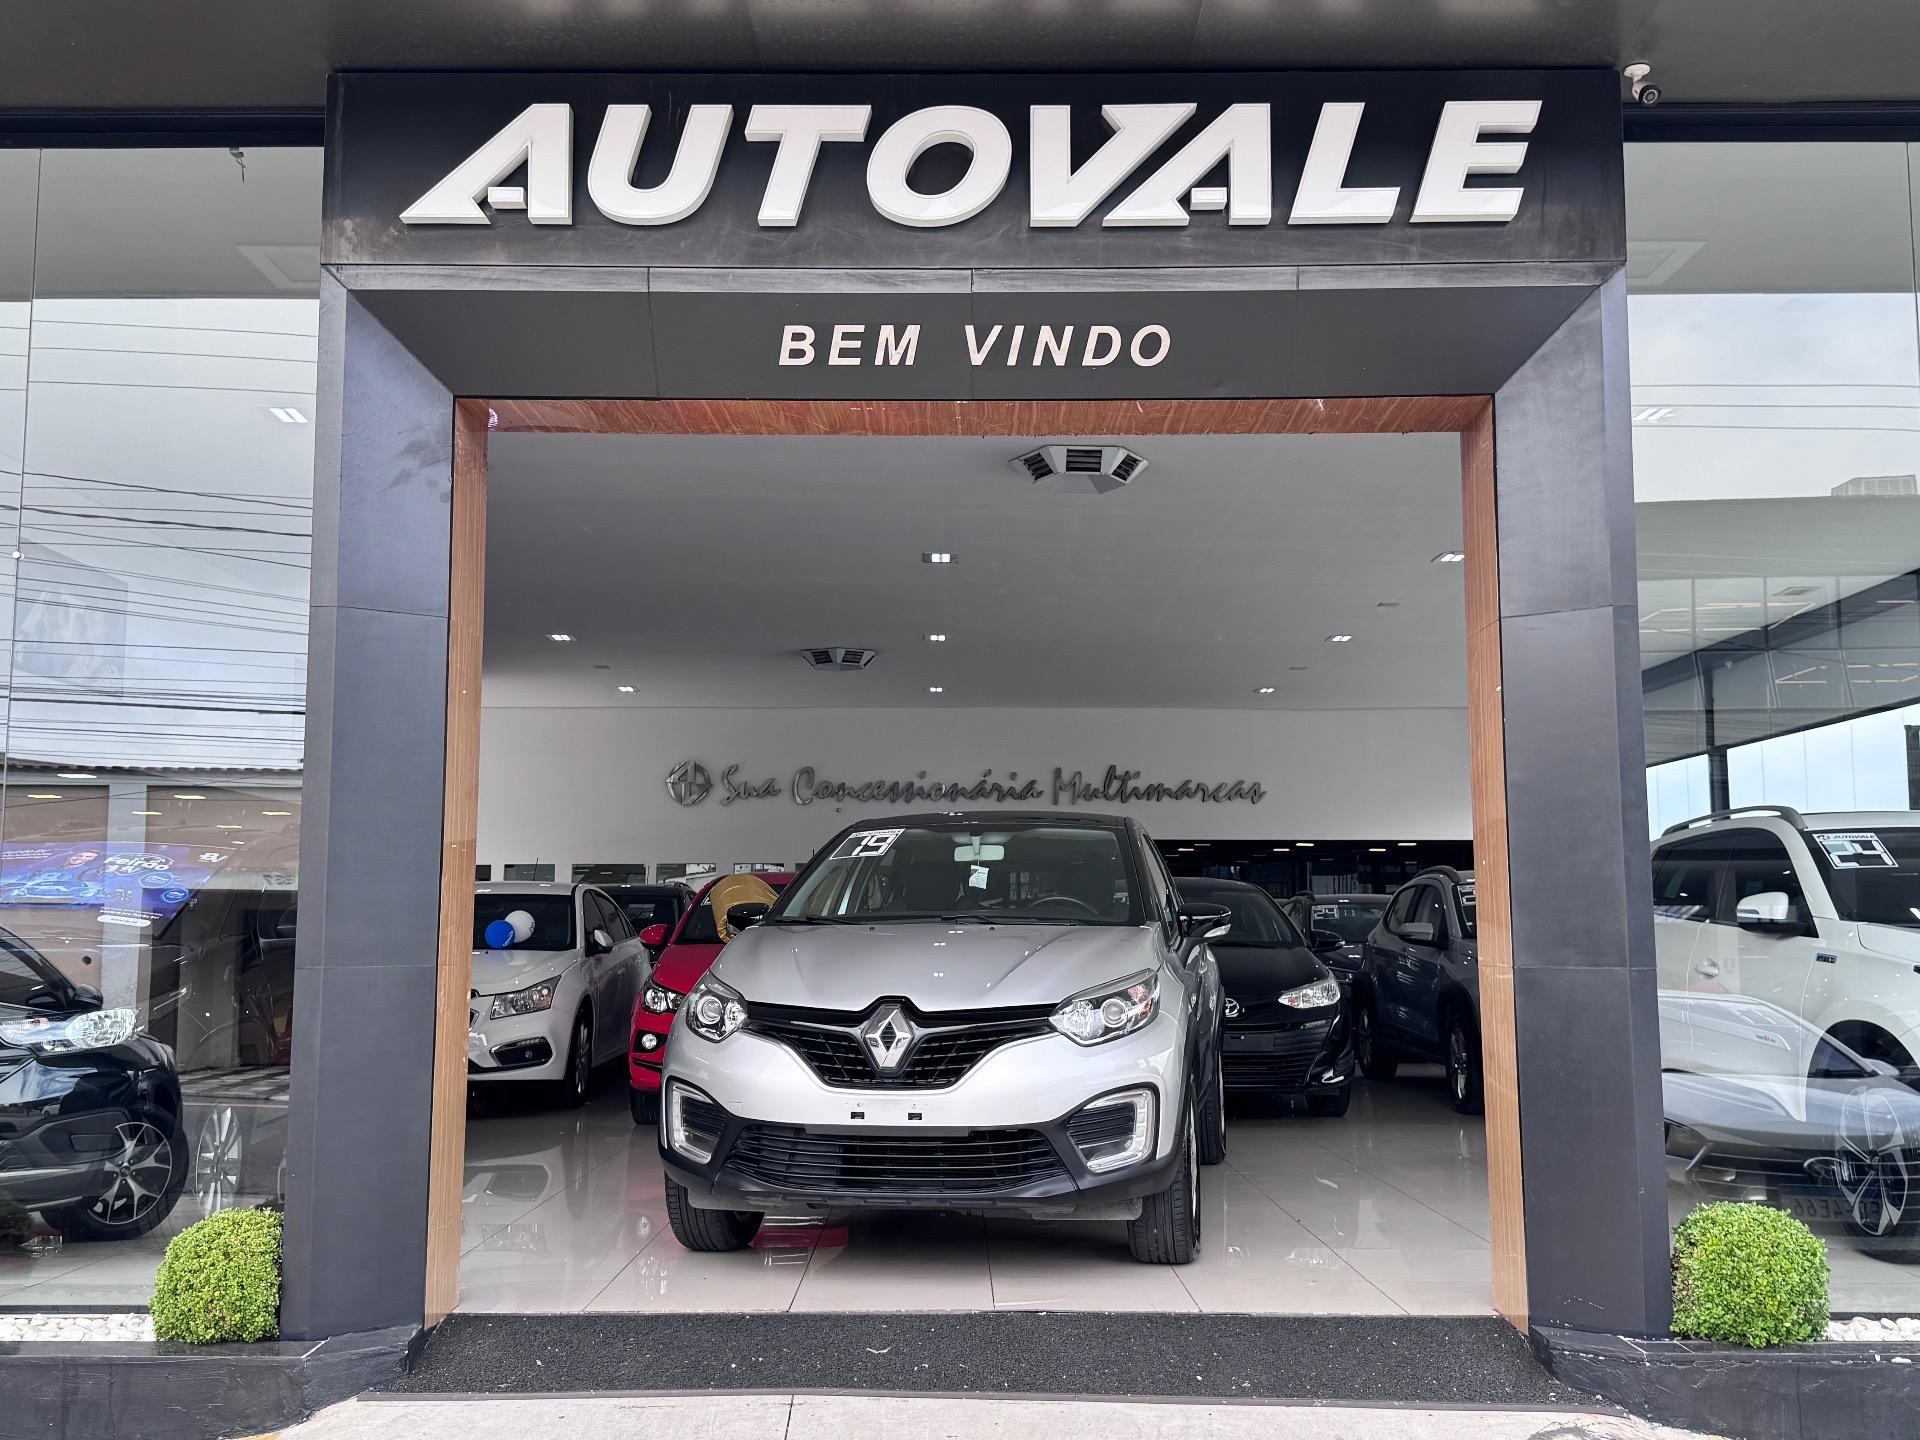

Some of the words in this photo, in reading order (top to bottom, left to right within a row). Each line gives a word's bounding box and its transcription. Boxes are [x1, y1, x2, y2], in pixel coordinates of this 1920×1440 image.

[399, 101, 1542, 227] AUTOVALE
[779, 325, 920, 365] BEM
[965, 325, 1170, 366] VINDO
[720, 764, 782, 806] Sua
[791, 766, 1044, 805] Concessionária
[1052, 764, 1267, 806] Multimarcas
[1821, 840, 1893, 867] 24
